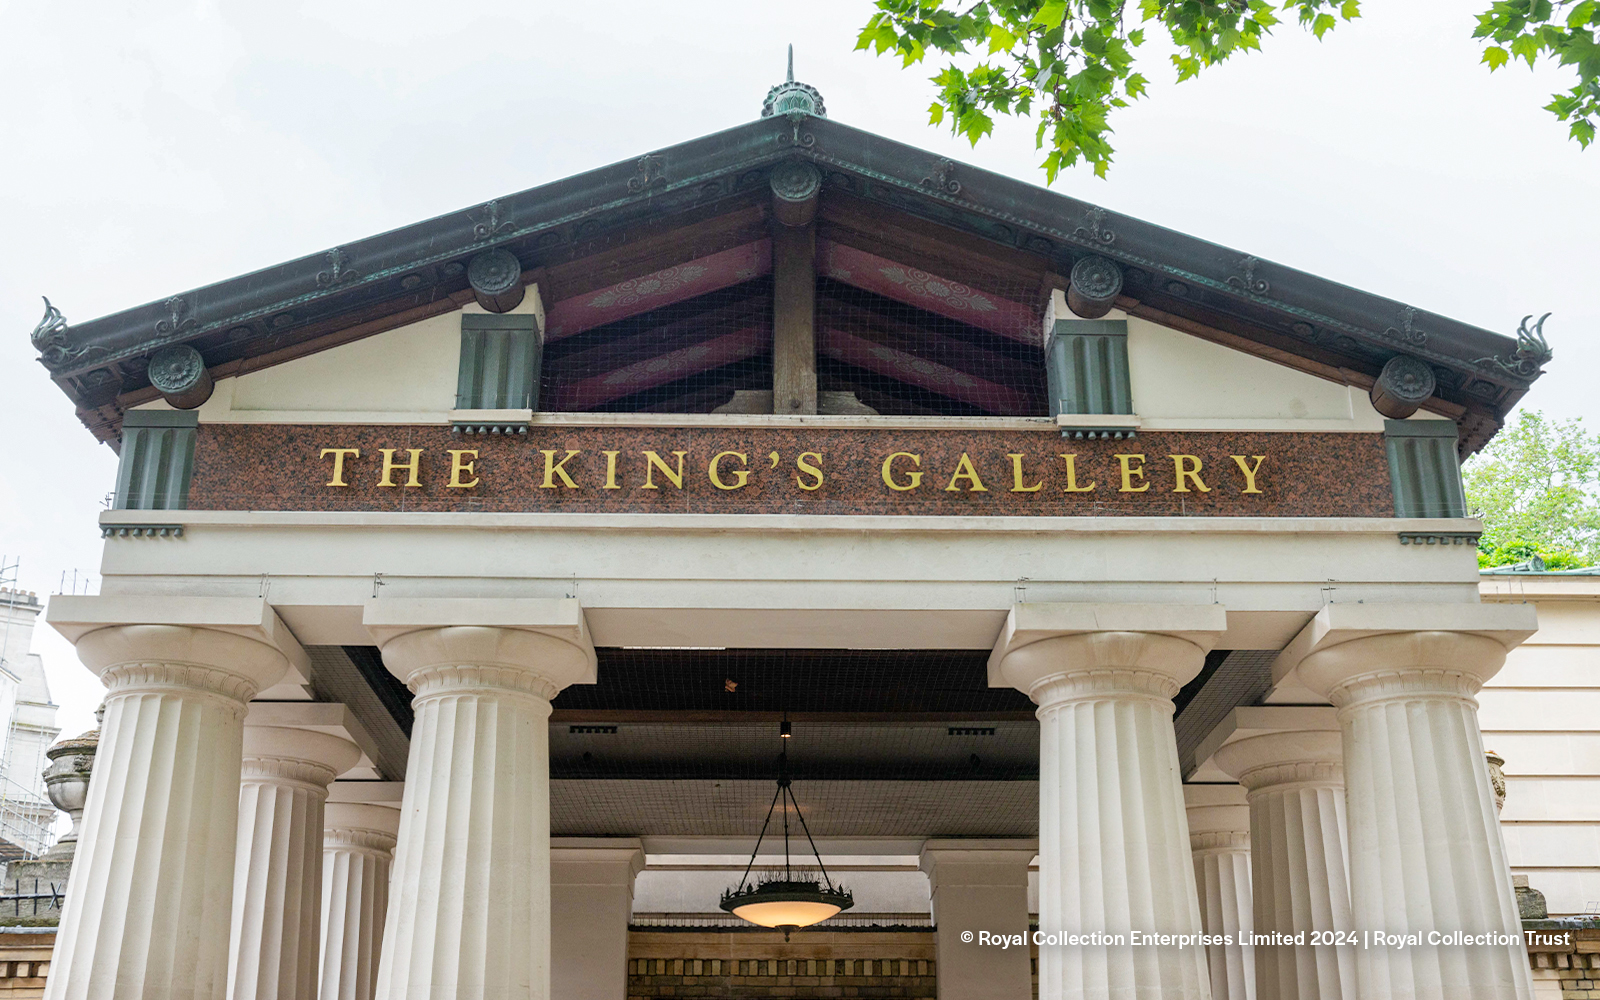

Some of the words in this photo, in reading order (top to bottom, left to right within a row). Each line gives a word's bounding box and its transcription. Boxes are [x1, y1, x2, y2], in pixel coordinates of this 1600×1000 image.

[319, 447, 480, 489] THE
[538, 449, 824, 491] KING’S
[881, 451, 1267, 494] GALLERY
